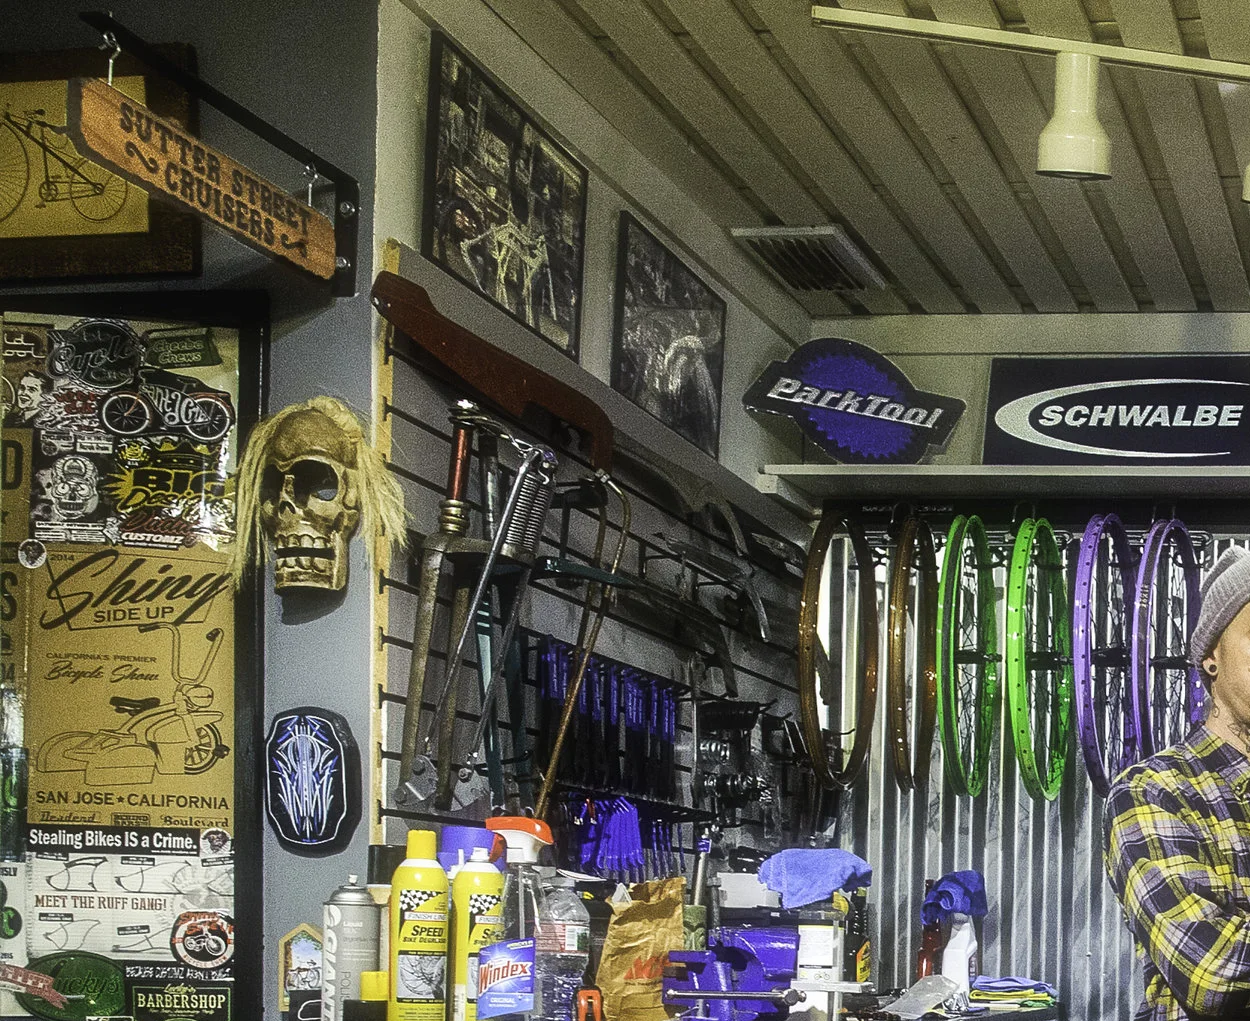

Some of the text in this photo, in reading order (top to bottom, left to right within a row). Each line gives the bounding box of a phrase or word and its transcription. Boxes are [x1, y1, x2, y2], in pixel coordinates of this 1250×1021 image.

[119, 101, 311, 236] SUTTER STREET
[164, 162, 276, 245] CRUISERS
[1038, 404, 1245, 428] SCHWALBE
[40, 549, 234, 630] Shiny
[94, 605, 175, 624] SIDE UP
[114, 654, 158, 663] PREMIER
[44, 660, 160, 684] Bicycle Show
[35, 790, 230, 810] SAN JOSE CALIFORNIA
[29, 828, 198, 850] Stealing Bikes IS a Crime.
[34, 894, 167, 911] MEET THE RUFF GANG!
[411, 925, 445, 937] SPEED
[480, 960, 529, 994] Windex
[137, 993, 226, 1010] BARBERSHOP
